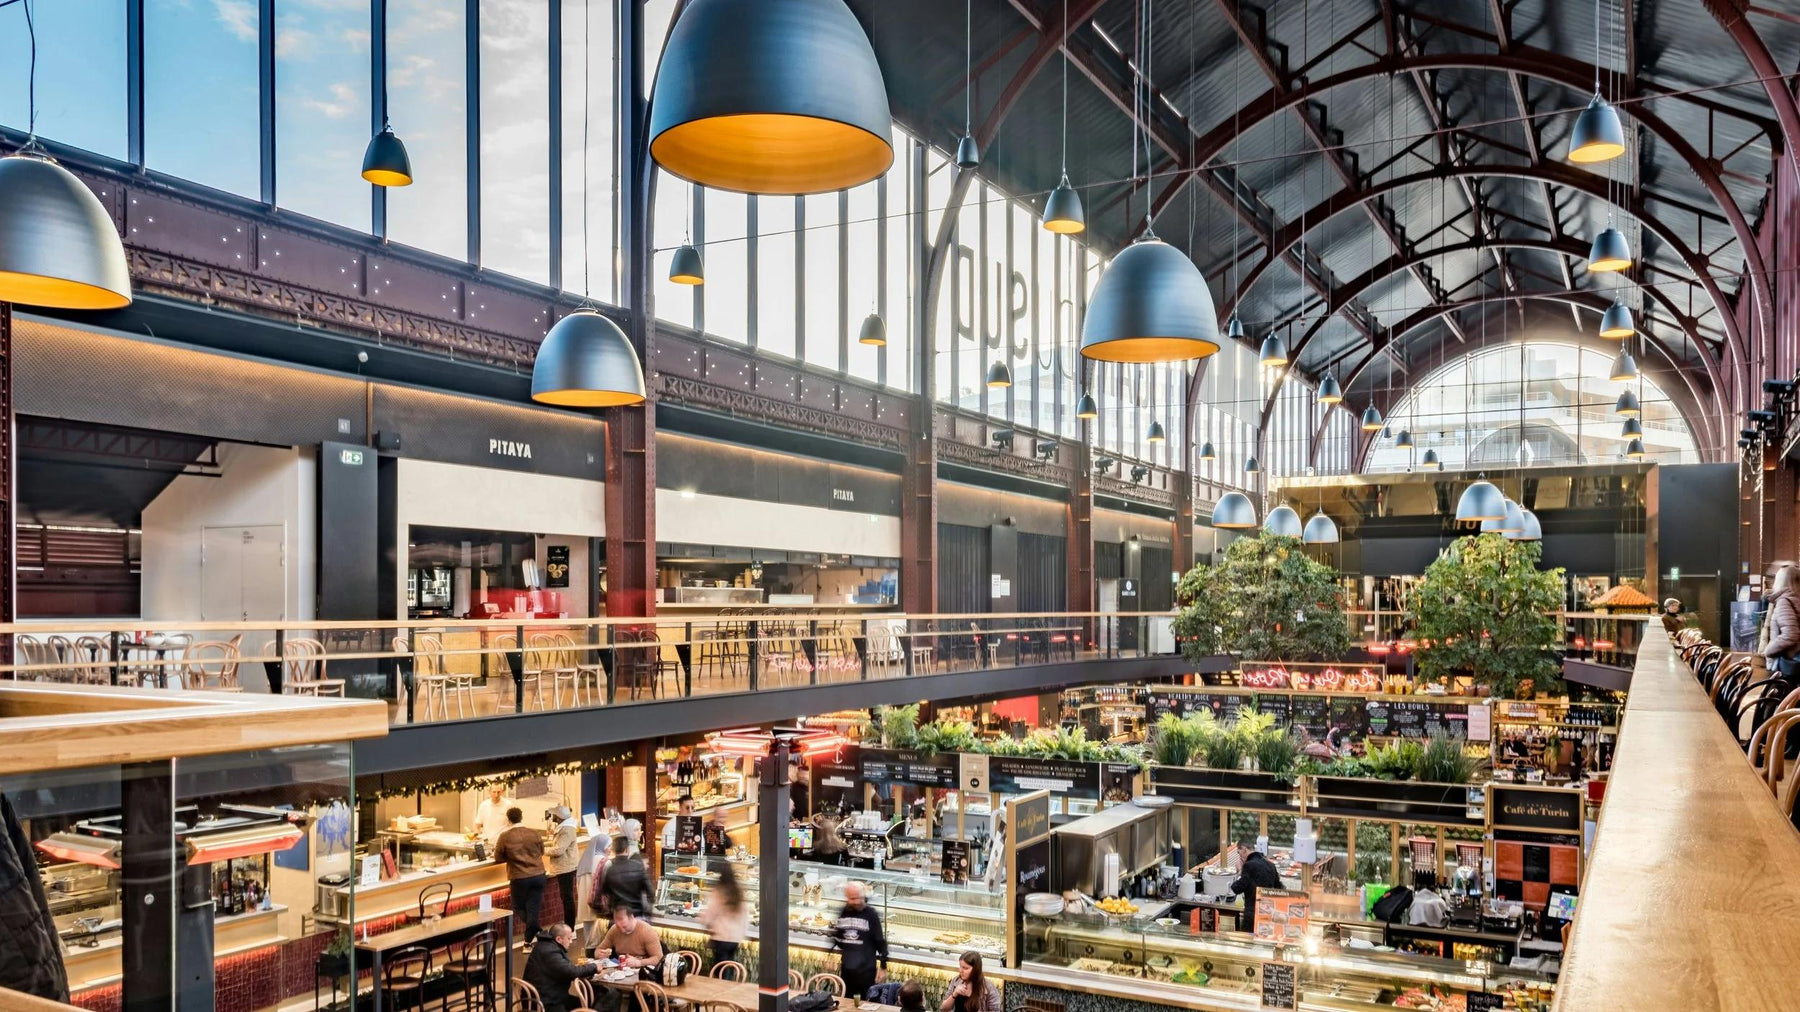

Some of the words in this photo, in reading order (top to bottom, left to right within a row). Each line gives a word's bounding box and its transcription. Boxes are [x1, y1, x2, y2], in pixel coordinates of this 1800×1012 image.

[489, 438, 532, 459] PITAYA
[833, 488, 855, 502] PITAYA
[1503, 804, 1526, 815] Café
[1526, 807, 1539, 815] de
[1540, 807, 1569, 817] Turin
